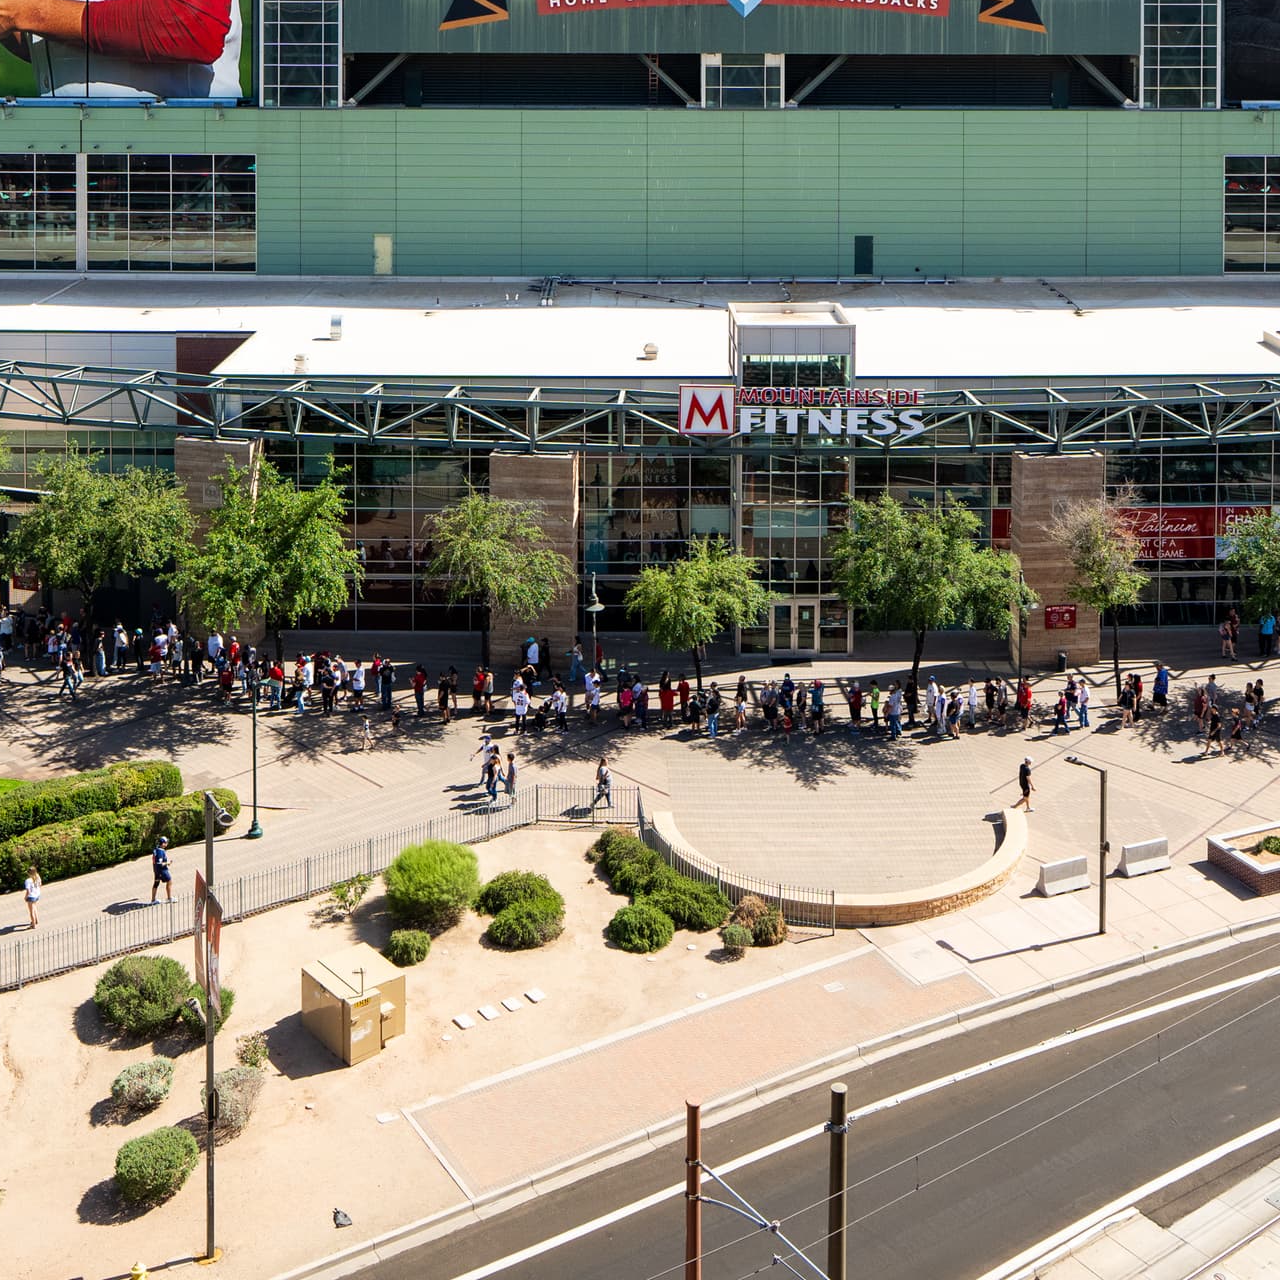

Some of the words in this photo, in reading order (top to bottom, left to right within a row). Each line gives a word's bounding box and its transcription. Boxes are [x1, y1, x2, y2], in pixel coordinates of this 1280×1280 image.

[738, 387, 926, 405] MOUNTAINSIDE
[685, 392, 729, 430] M
[739, 408, 925, 435] FITNESS
[624, 475, 677, 483] FITNESS
[1156, 549, 1187, 558] GAME.
